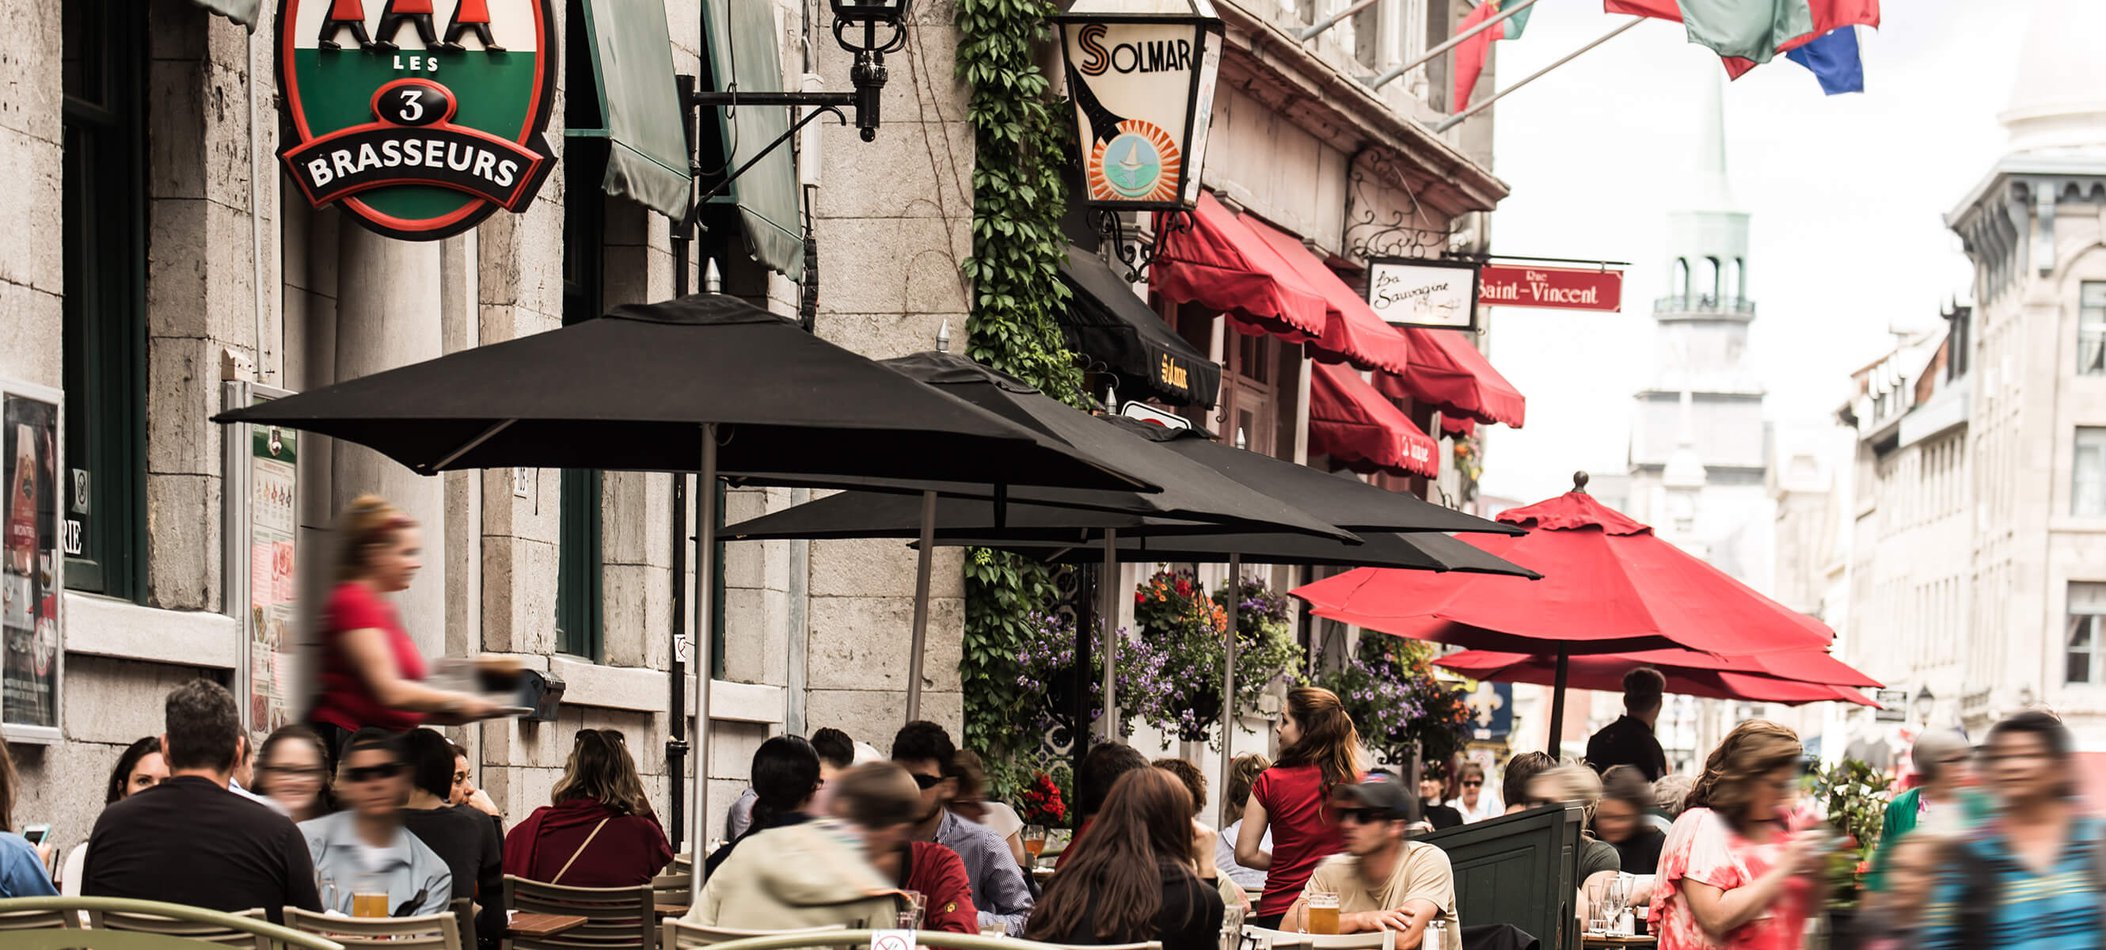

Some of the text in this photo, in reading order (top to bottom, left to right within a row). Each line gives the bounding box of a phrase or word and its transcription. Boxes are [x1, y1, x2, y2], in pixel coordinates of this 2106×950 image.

[1078, 23, 1192, 76] SOLMAR
[393, 55, 438, 72] LES
[399, 90, 424, 121] 3
[307, 139, 519, 188] BRASSEURS
[1376, 270, 1399, 288] La
[1526, 270, 1547, 281] Rue
[1374, 282, 1448, 309] Sauvagine
